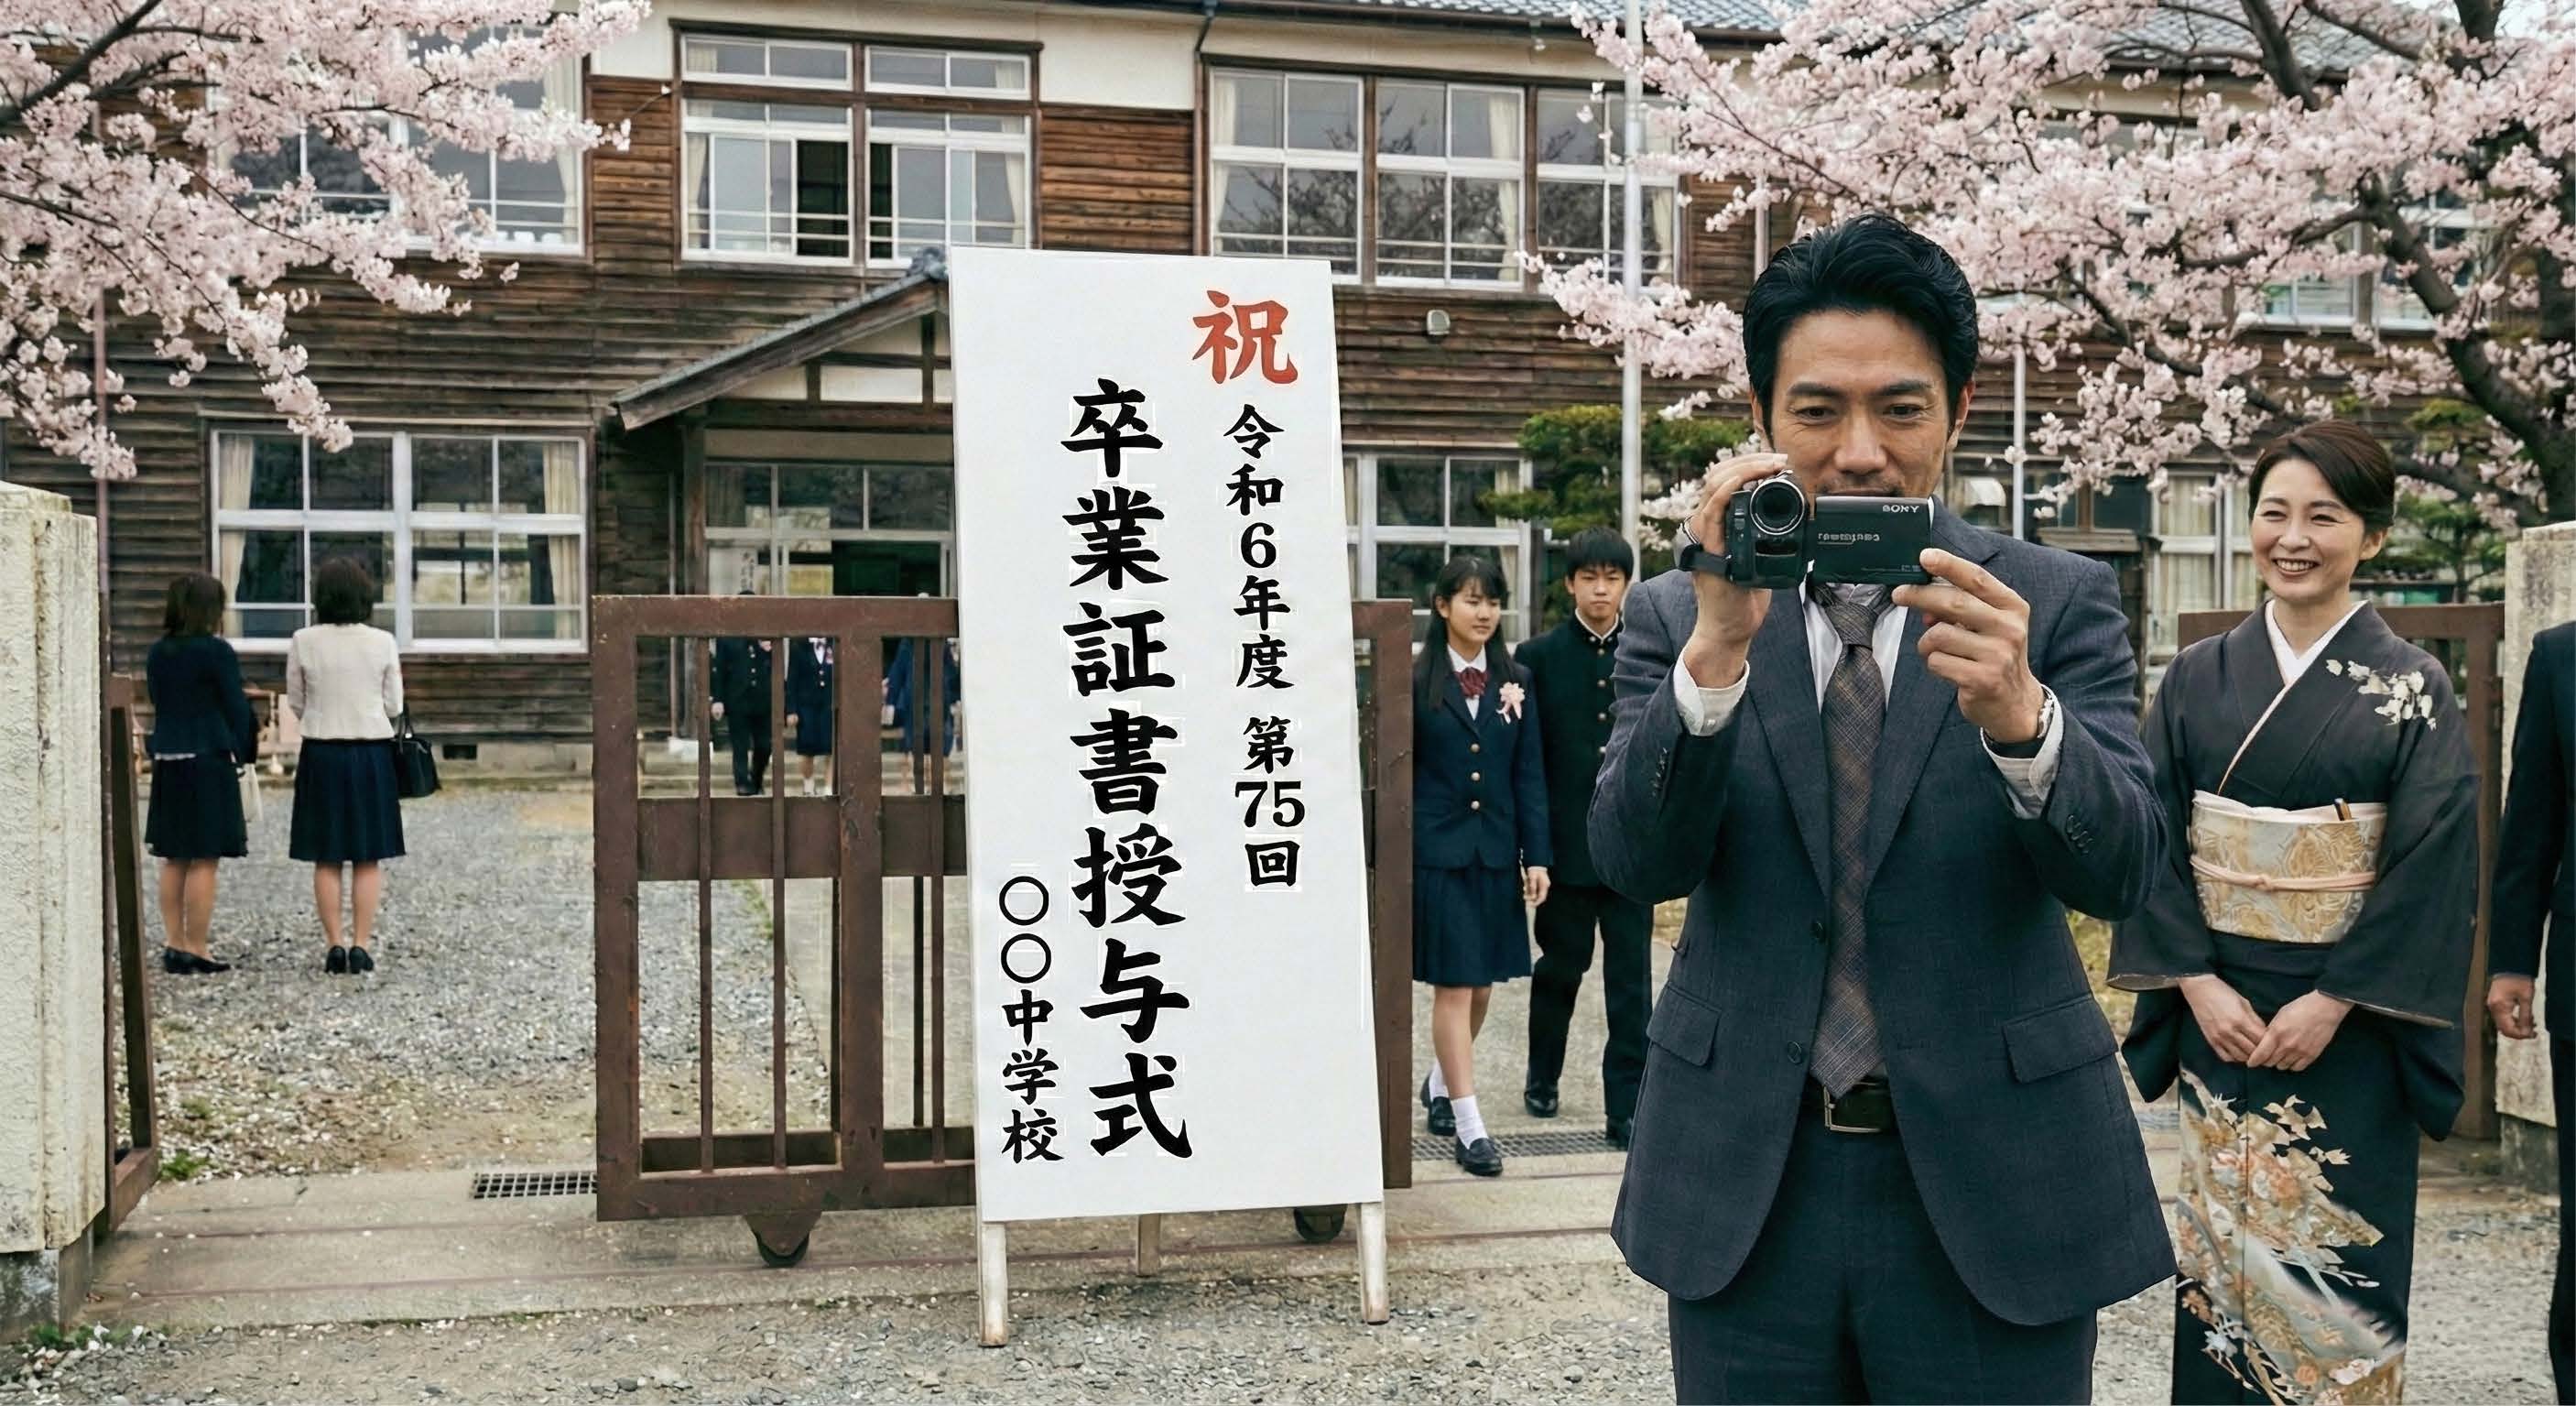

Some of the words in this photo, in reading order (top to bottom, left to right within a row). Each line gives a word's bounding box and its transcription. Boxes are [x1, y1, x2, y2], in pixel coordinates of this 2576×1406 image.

[1192, 289, 1299, 385] 祝
[1223, 403, 1295, 691] 令和6年度
[1060, 376, 1194, 1161] 卒業証書授与式
[1234, 714, 1307, 888] 第75回
